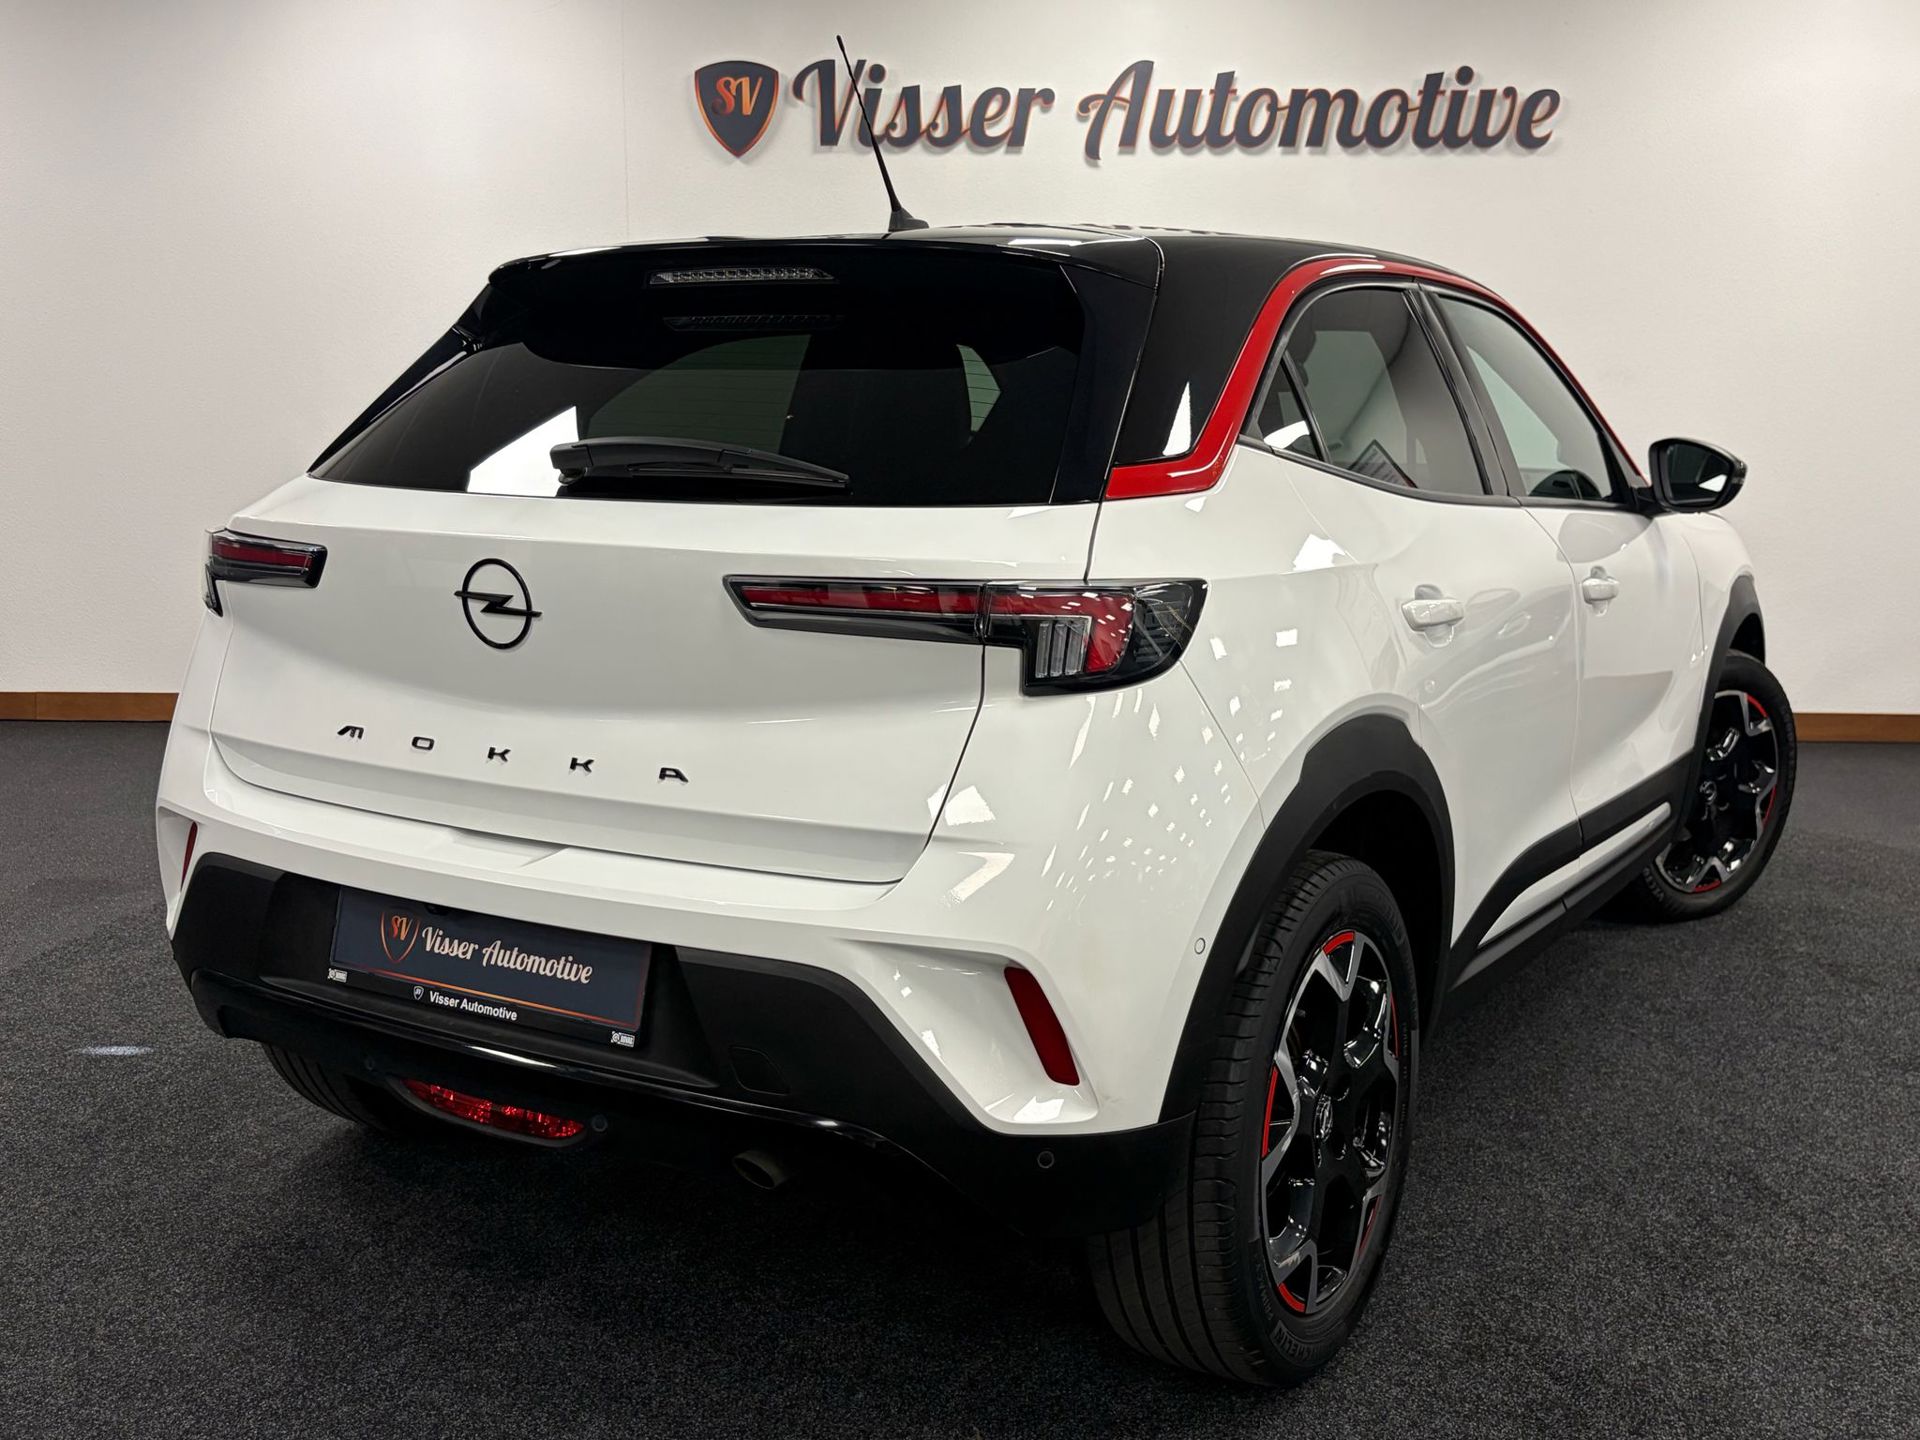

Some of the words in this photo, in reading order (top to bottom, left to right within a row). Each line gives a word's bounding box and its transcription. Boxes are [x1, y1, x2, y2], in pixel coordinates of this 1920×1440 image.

[711, 76, 763, 117] SV
[791, 58, 1057, 149] Visser
[1077, 59, 1561, 161] Automotive
[337, 724, 690, 784] MOKKA
[421, 926, 479, 961] Visser
[482, 940, 593, 984] Automotive
[429, 990, 460, 1008] Visser
[460, 998, 518, 1021] Automotive
